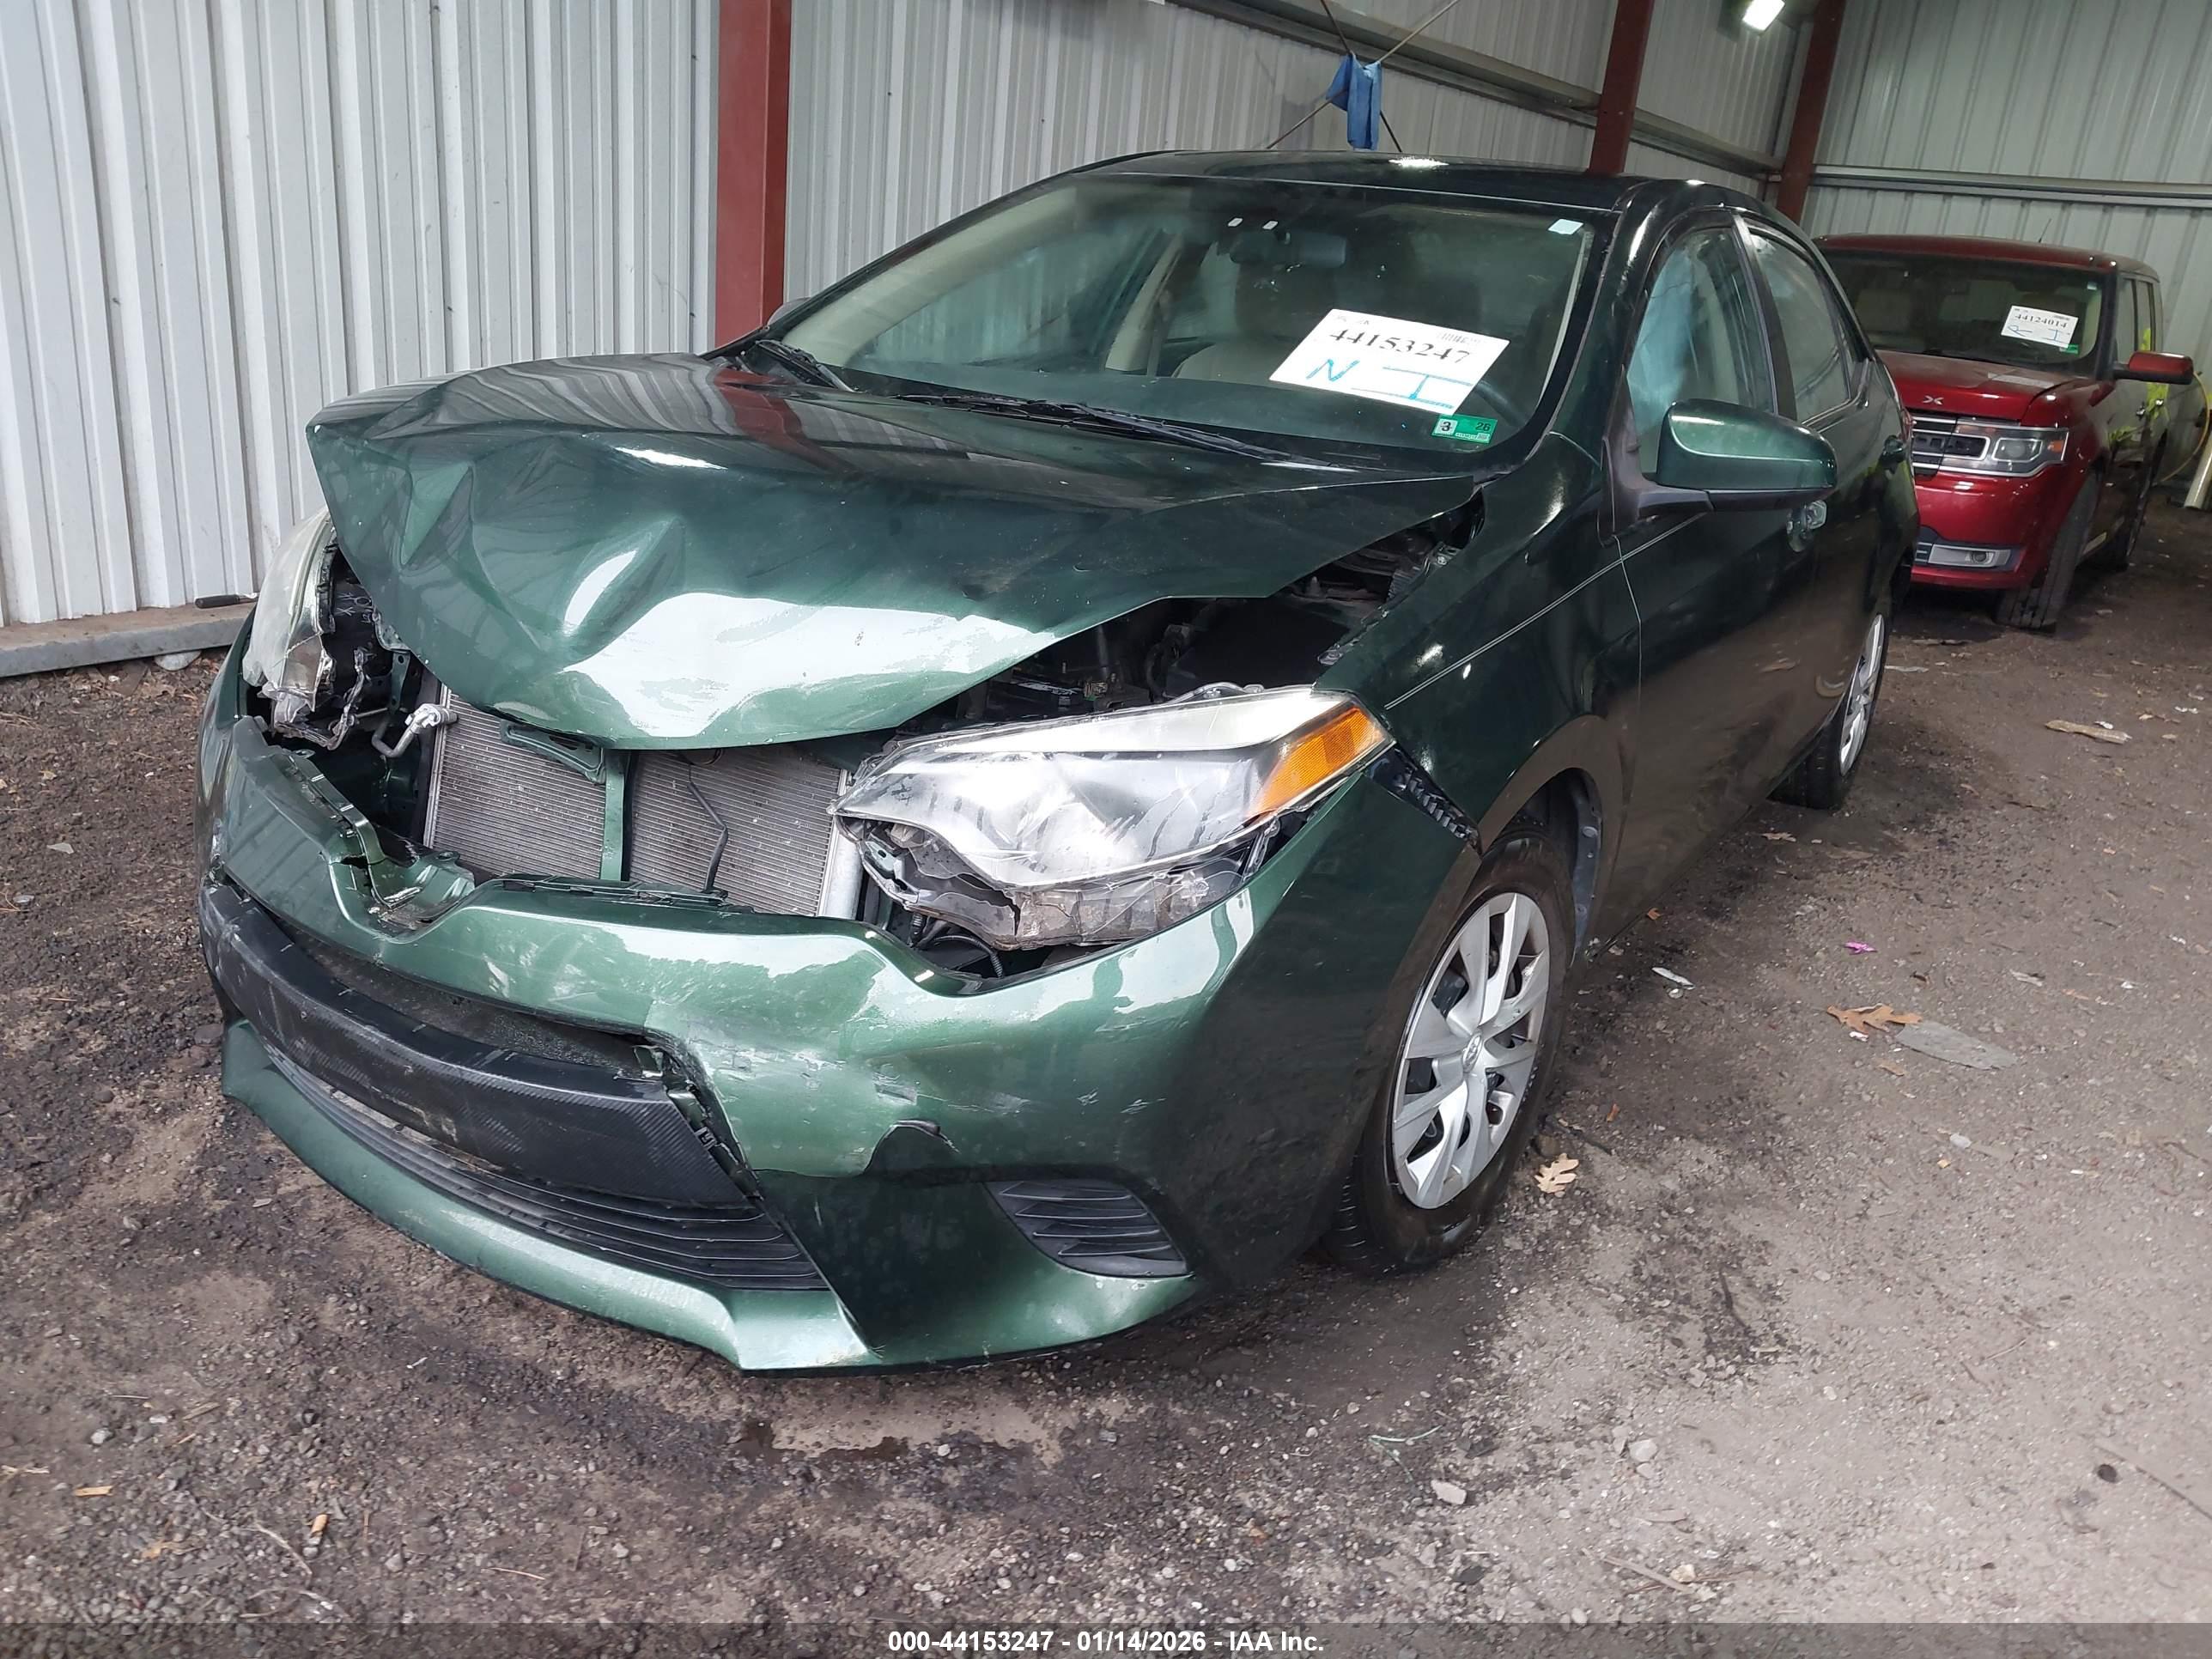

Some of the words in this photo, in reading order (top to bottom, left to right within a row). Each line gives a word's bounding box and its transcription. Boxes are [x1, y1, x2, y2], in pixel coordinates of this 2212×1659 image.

[2014, 314, 2068, 329] 44124014
[1329, 329, 1470, 364] 44153247
[1440, 422, 1453, 432] 3
[1475, 422, 1492, 432] 26
